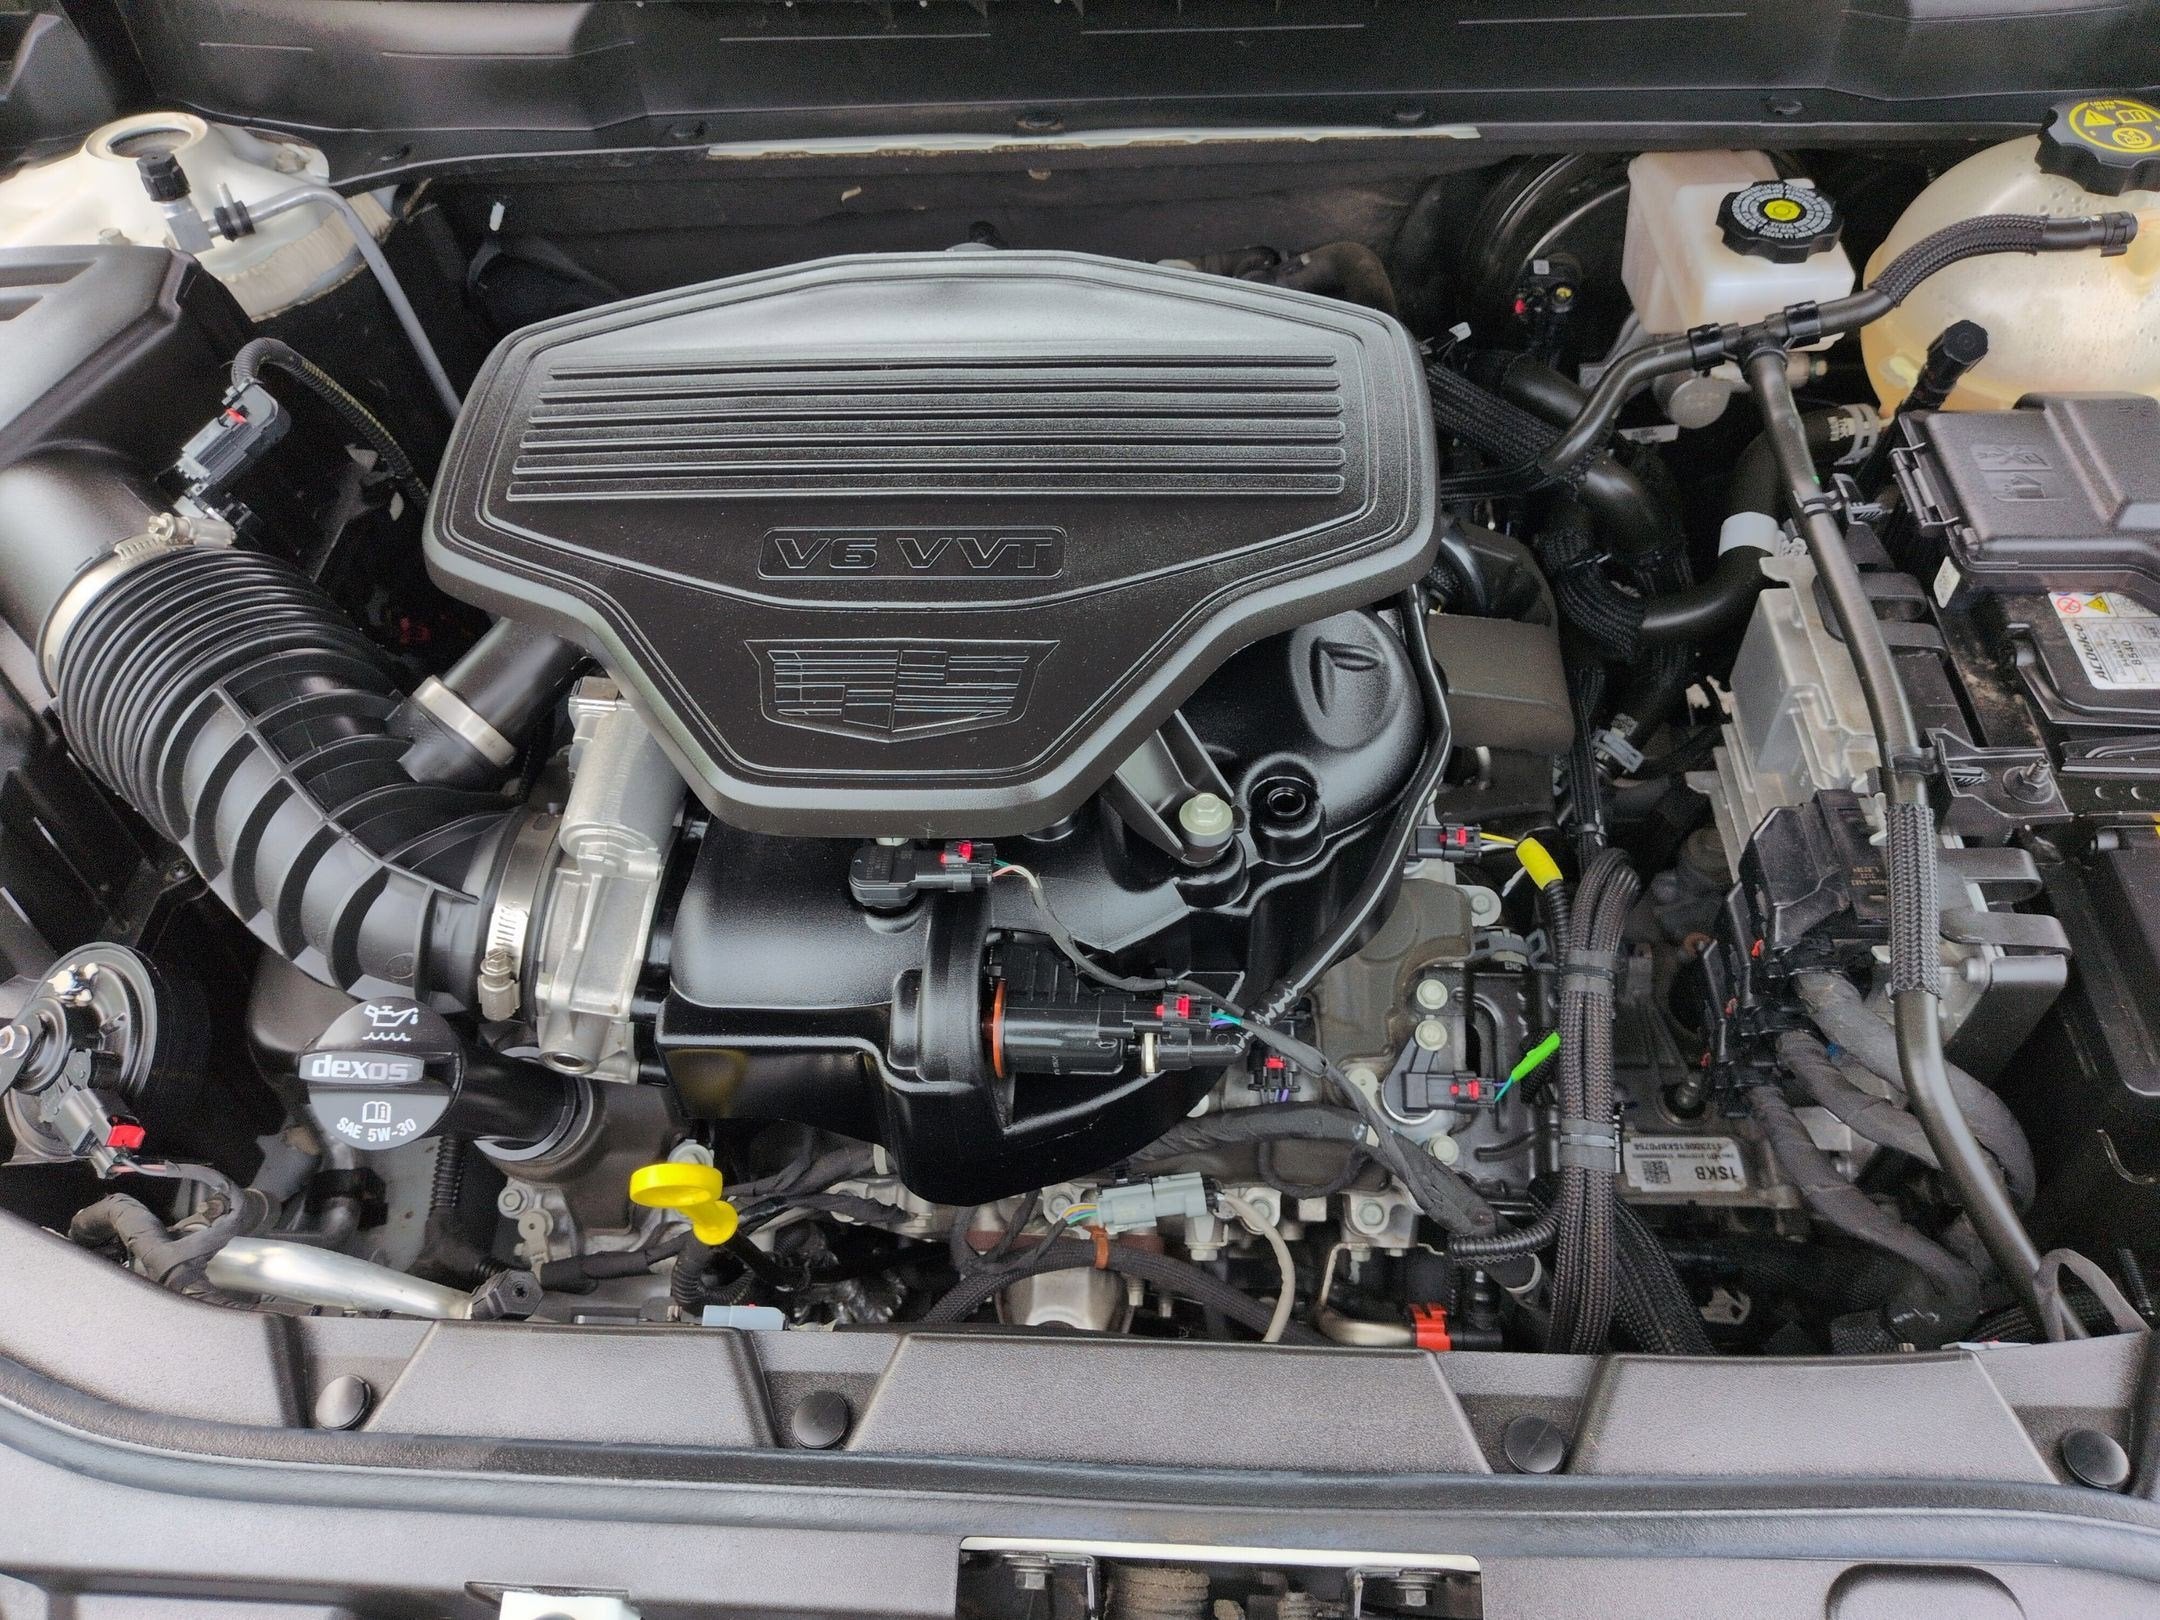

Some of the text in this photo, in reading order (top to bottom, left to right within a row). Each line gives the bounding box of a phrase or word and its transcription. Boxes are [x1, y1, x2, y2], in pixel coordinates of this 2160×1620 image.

[775, 537, 1053, 569] V6 VVT
[311, 1054, 409, 1081] dexos
[336, 1117, 416, 1142] SAE 5W-30
[1695, 1166, 1738, 1180] 1SKB
